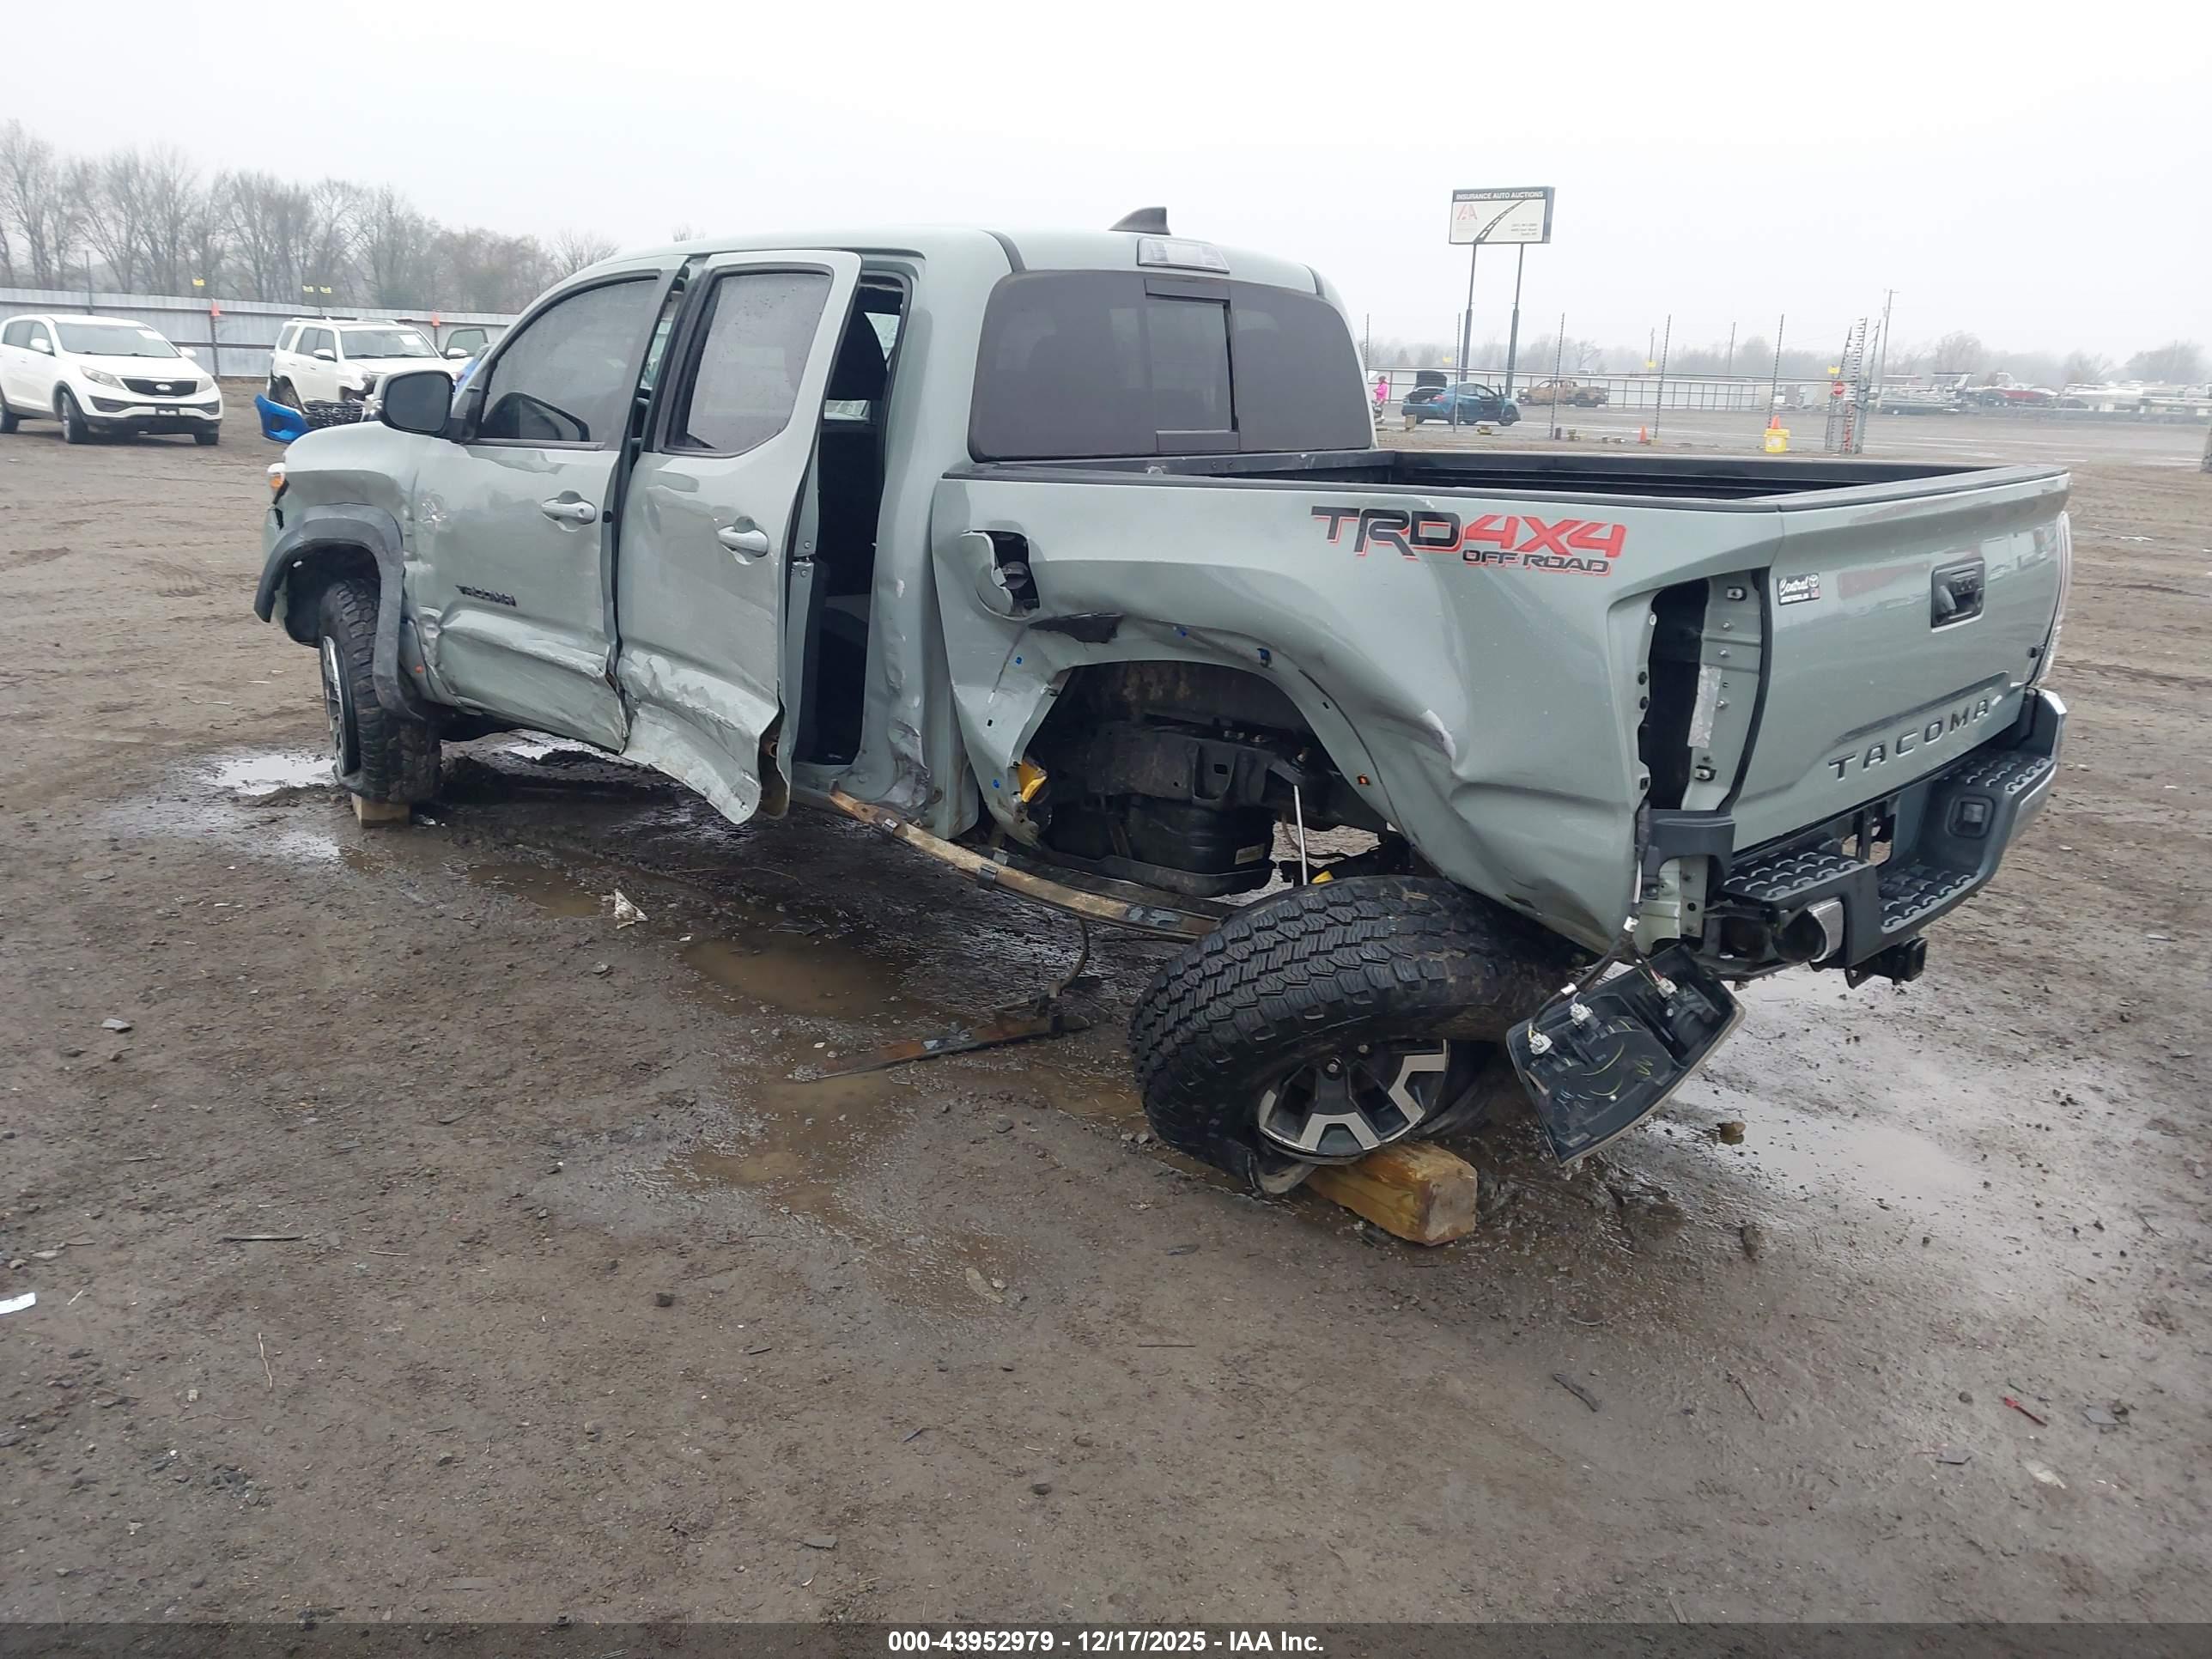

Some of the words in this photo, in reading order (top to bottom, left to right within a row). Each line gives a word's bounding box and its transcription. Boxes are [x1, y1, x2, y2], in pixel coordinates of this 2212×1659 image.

[1311, 506, 1462, 561] TRD
[1462, 514, 1626, 558] 4X4
[1462, 549, 1518, 567] OFF
[1522, 556, 1611, 576] ROAD
[1828, 698, 1990, 781] TACOMA
